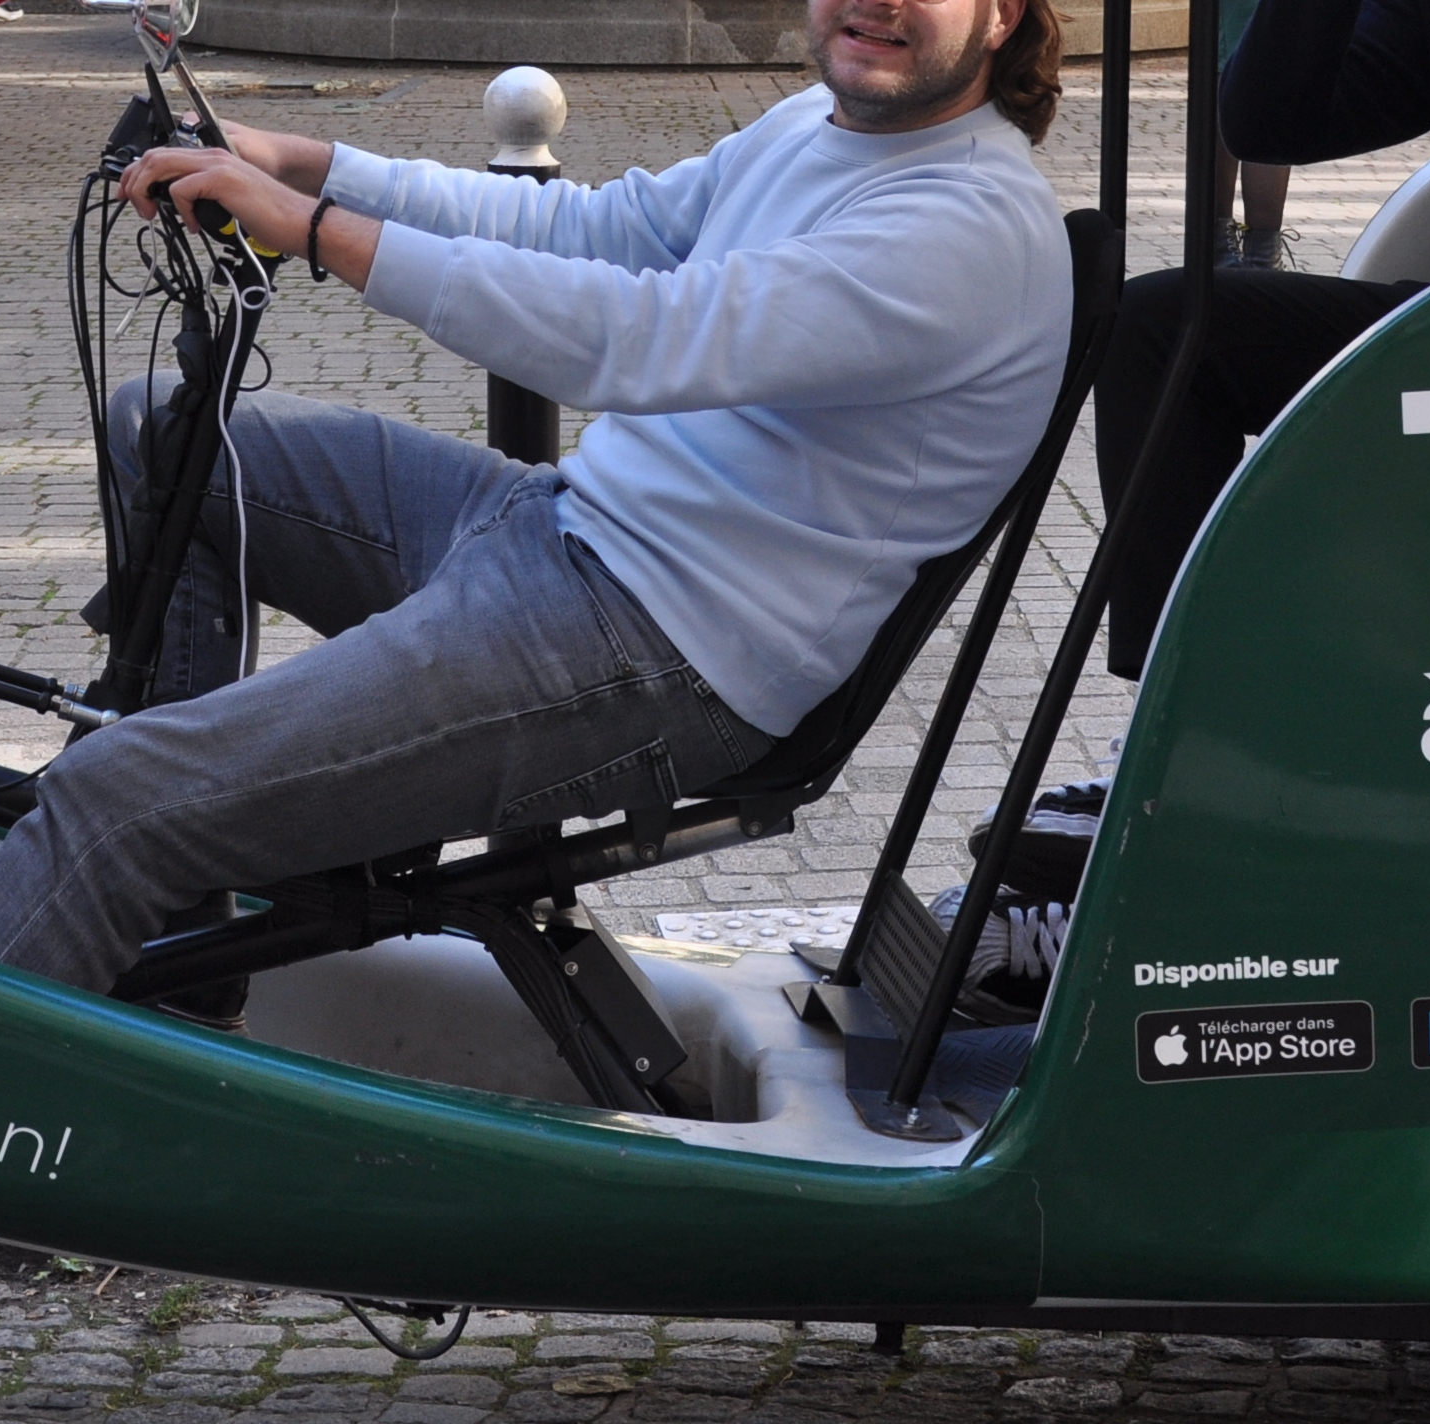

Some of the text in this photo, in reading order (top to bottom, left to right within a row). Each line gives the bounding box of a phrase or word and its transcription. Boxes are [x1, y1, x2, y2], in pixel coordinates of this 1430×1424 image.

[1133, 955, 1340, 988] Disponible sur
[1198, 1017, 1335, 1035] Télécharger dans
[1200, 1033, 1357, 1066] l'App Store
